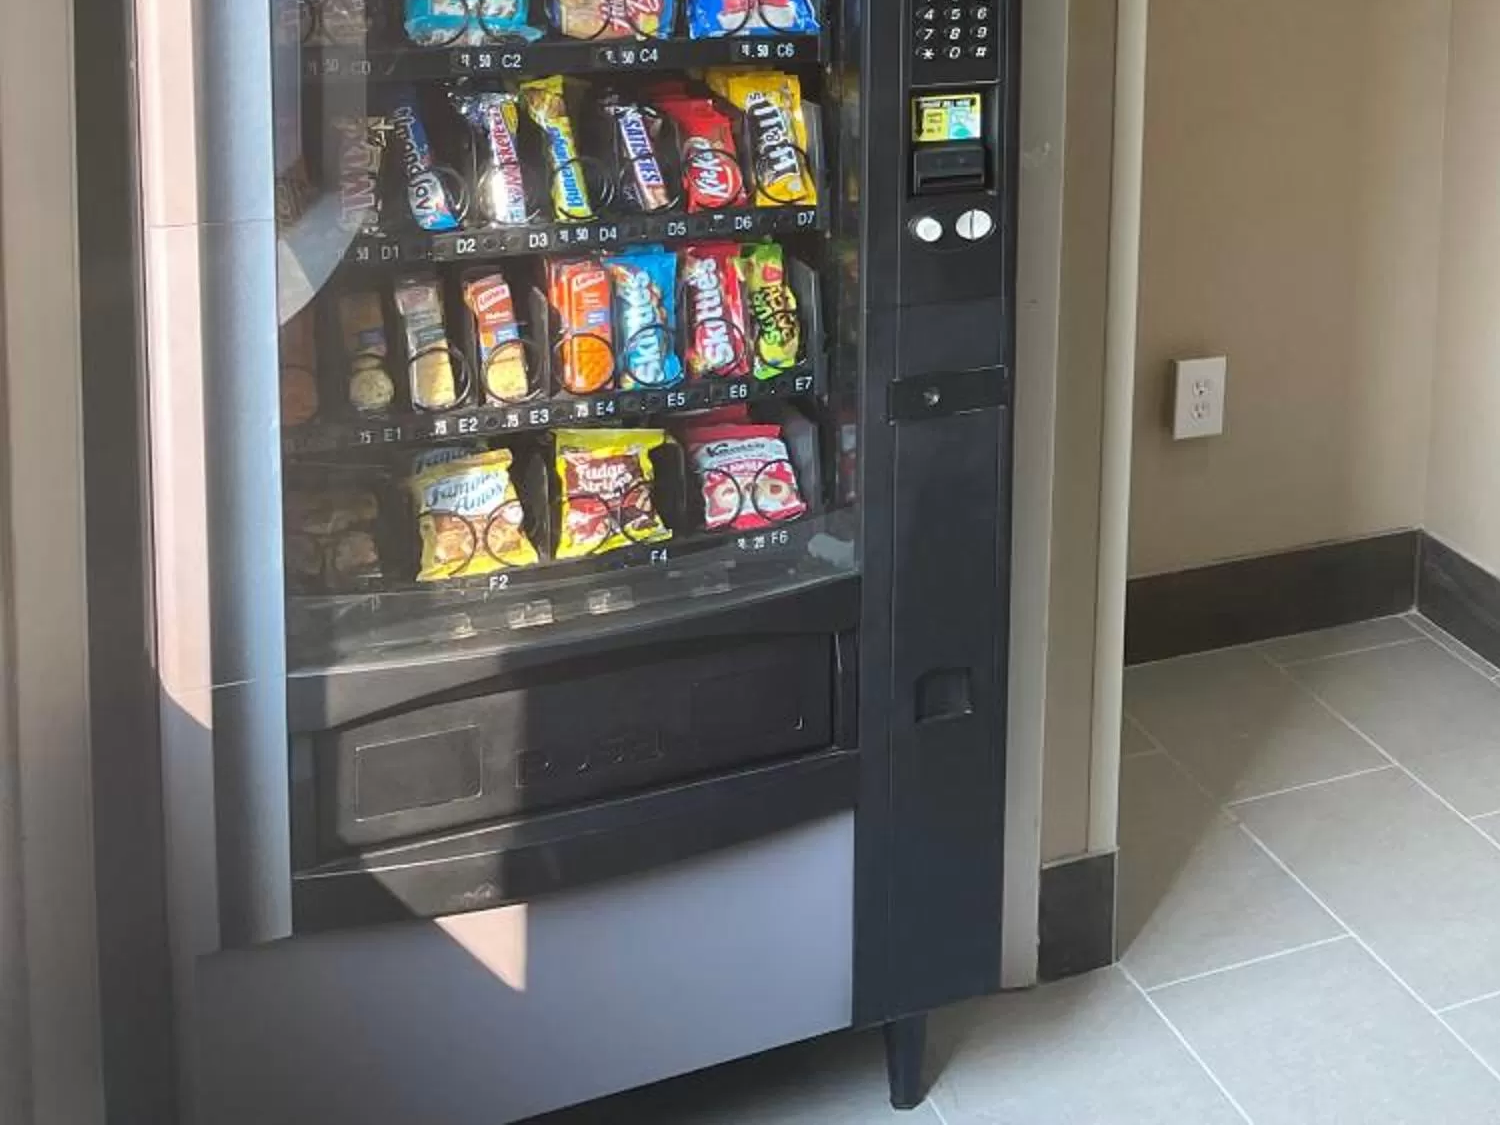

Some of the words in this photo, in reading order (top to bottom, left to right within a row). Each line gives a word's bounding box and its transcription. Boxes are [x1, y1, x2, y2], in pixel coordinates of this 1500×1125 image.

[924, 8, 935, 20] 4
[951, 8, 961, 20] 5
[977, 7, 987, 20] 6
[924, 28, 934, 40] 7
[949, 27, 961, 40] 8
[977, 26, 987, 38] 9
[639, 48, 658, 63] C4
[777, 42, 795, 57] C6
[501, 53, 522, 69] C2
[734, 216, 753, 230] D6
[797, 210, 815, 225] D7
[599, 226, 618, 241] D4
[667, 222, 687, 236] D5
[456, 238, 476, 253] D2
[529, 233, 548, 248] D3
[381, 244, 400, 260] D1
[690, 258, 735, 366] Skittles
[751, 292, 784, 345] SOUR
[795, 376, 812, 391] E7
[729, 384, 747, 399] E6
[667, 393, 685, 407] E5
[596, 401, 615, 416] E4
[458, 417, 478, 432] E2
[530, 410, 549, 424] E3
[383, 427, 400, 442] E1
[771, 531, 788, 544] F6
[650, 548, 668, 562] F4
[488, 575, 508, 590] F2
